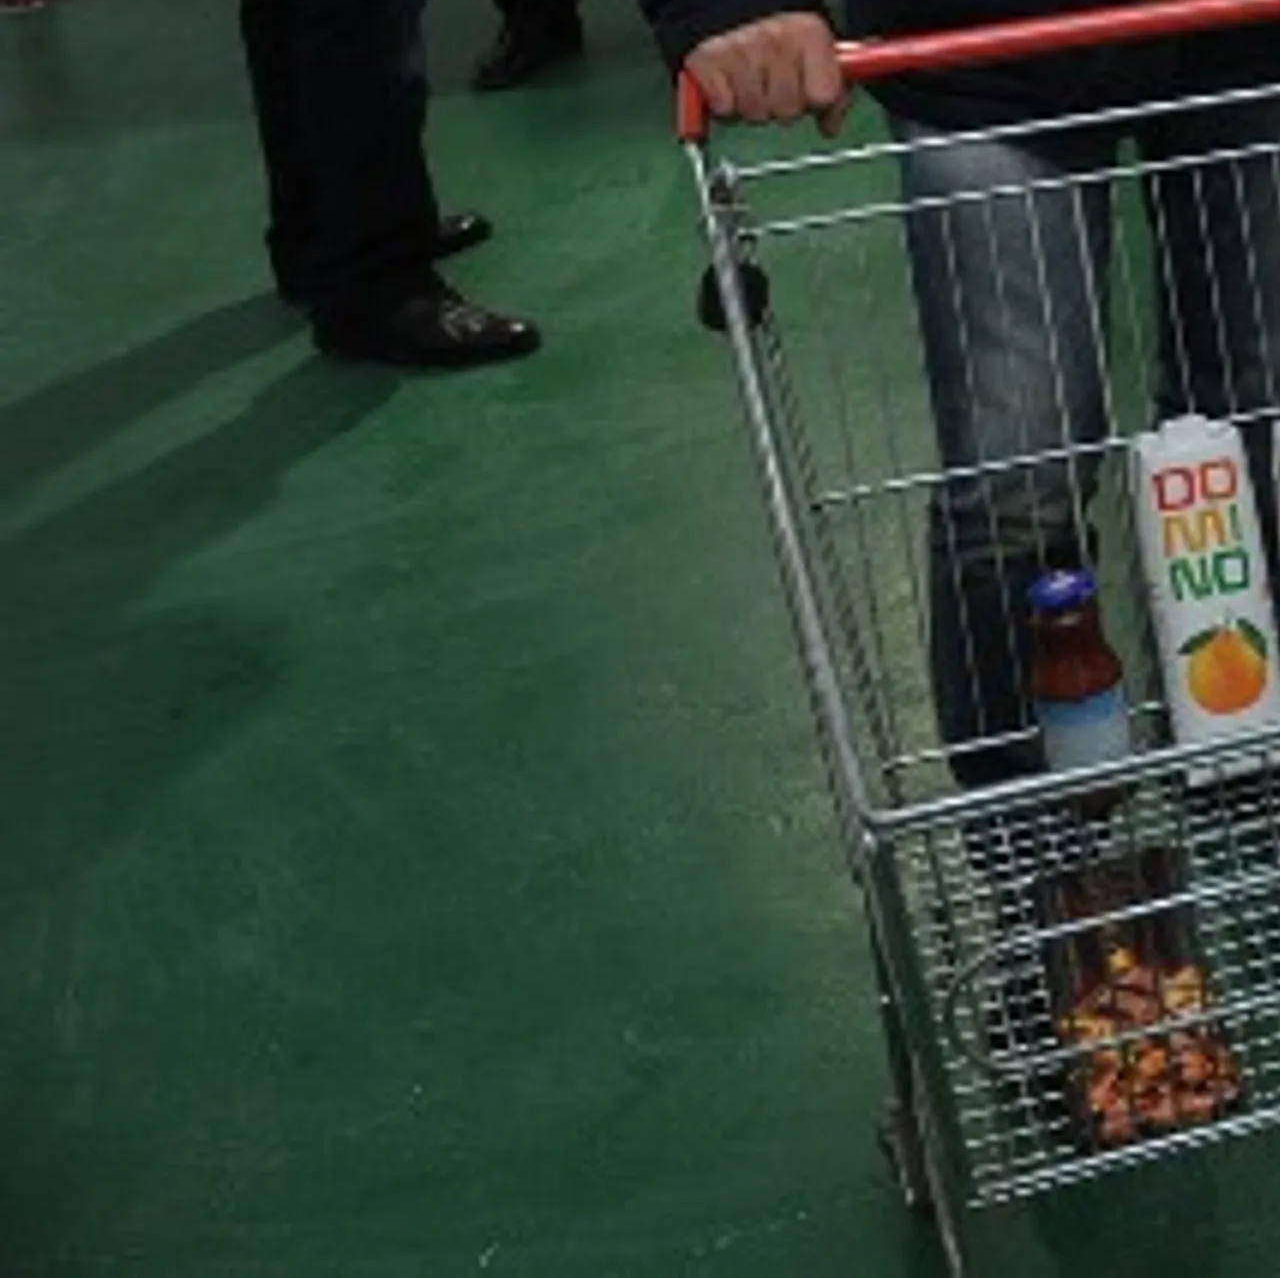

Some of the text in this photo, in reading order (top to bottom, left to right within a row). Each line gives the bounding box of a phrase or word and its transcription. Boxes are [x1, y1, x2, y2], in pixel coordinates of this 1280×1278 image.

[1152, 457, 1238, 512] DO
[1162, 508, 1243, 558] MI
[1168, 548, 1250, 601] NO
